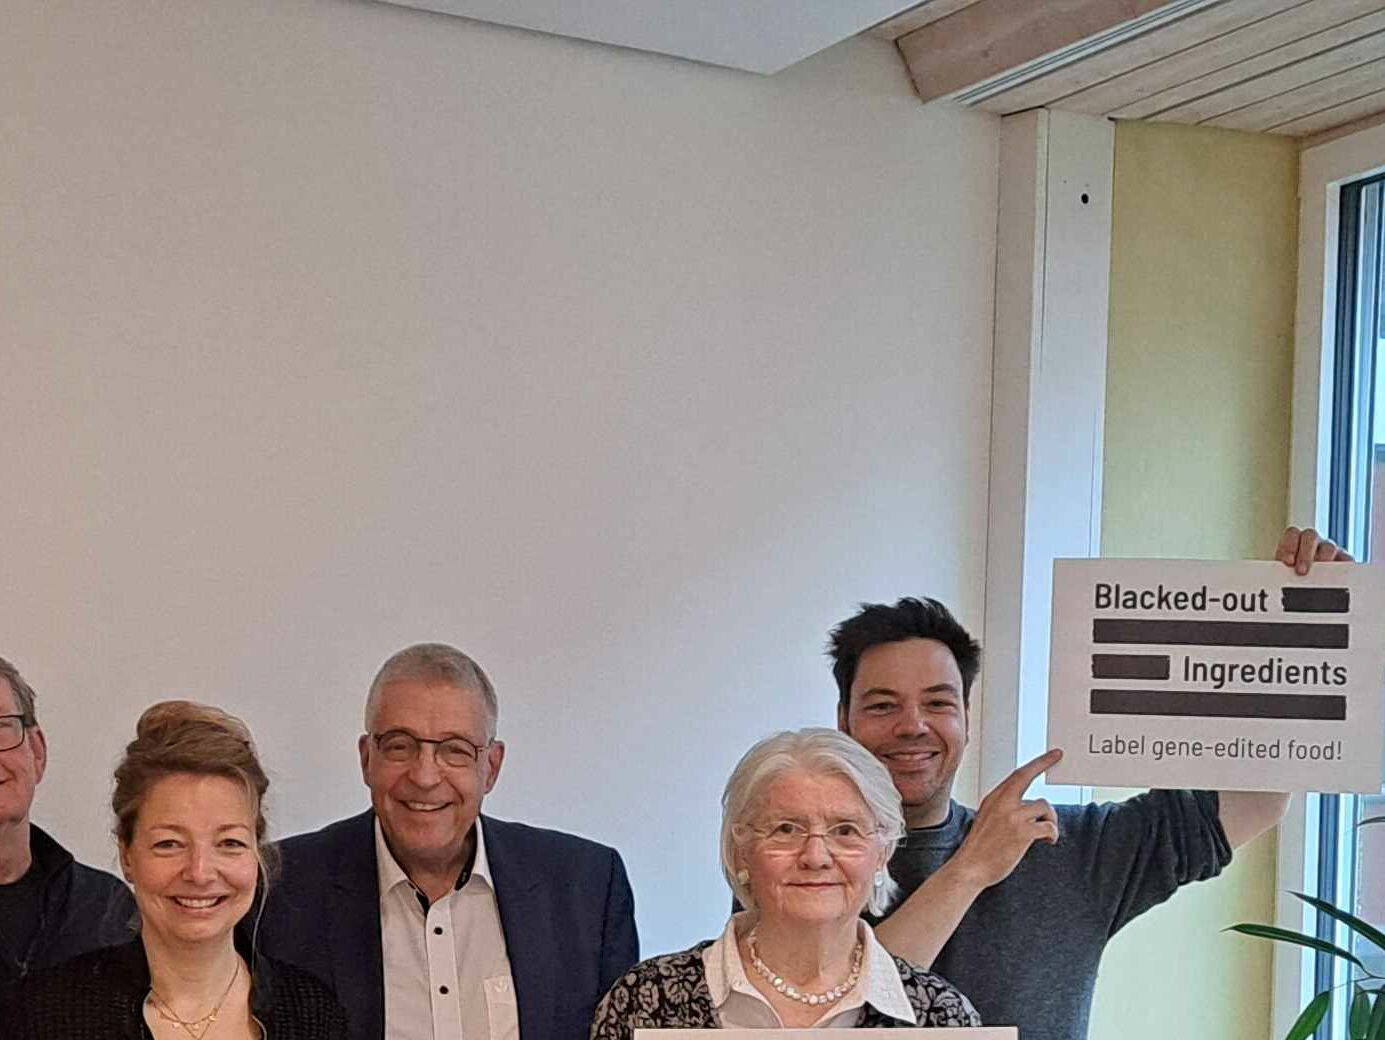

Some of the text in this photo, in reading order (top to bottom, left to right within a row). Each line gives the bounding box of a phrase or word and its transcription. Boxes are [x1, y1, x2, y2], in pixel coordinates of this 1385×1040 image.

[1095, 583, 1269, 612] Blacked-out
[1183, 655, 1348, 689] Ingredients
[1088, 733, 1343, 761] Label gene-edited food!
